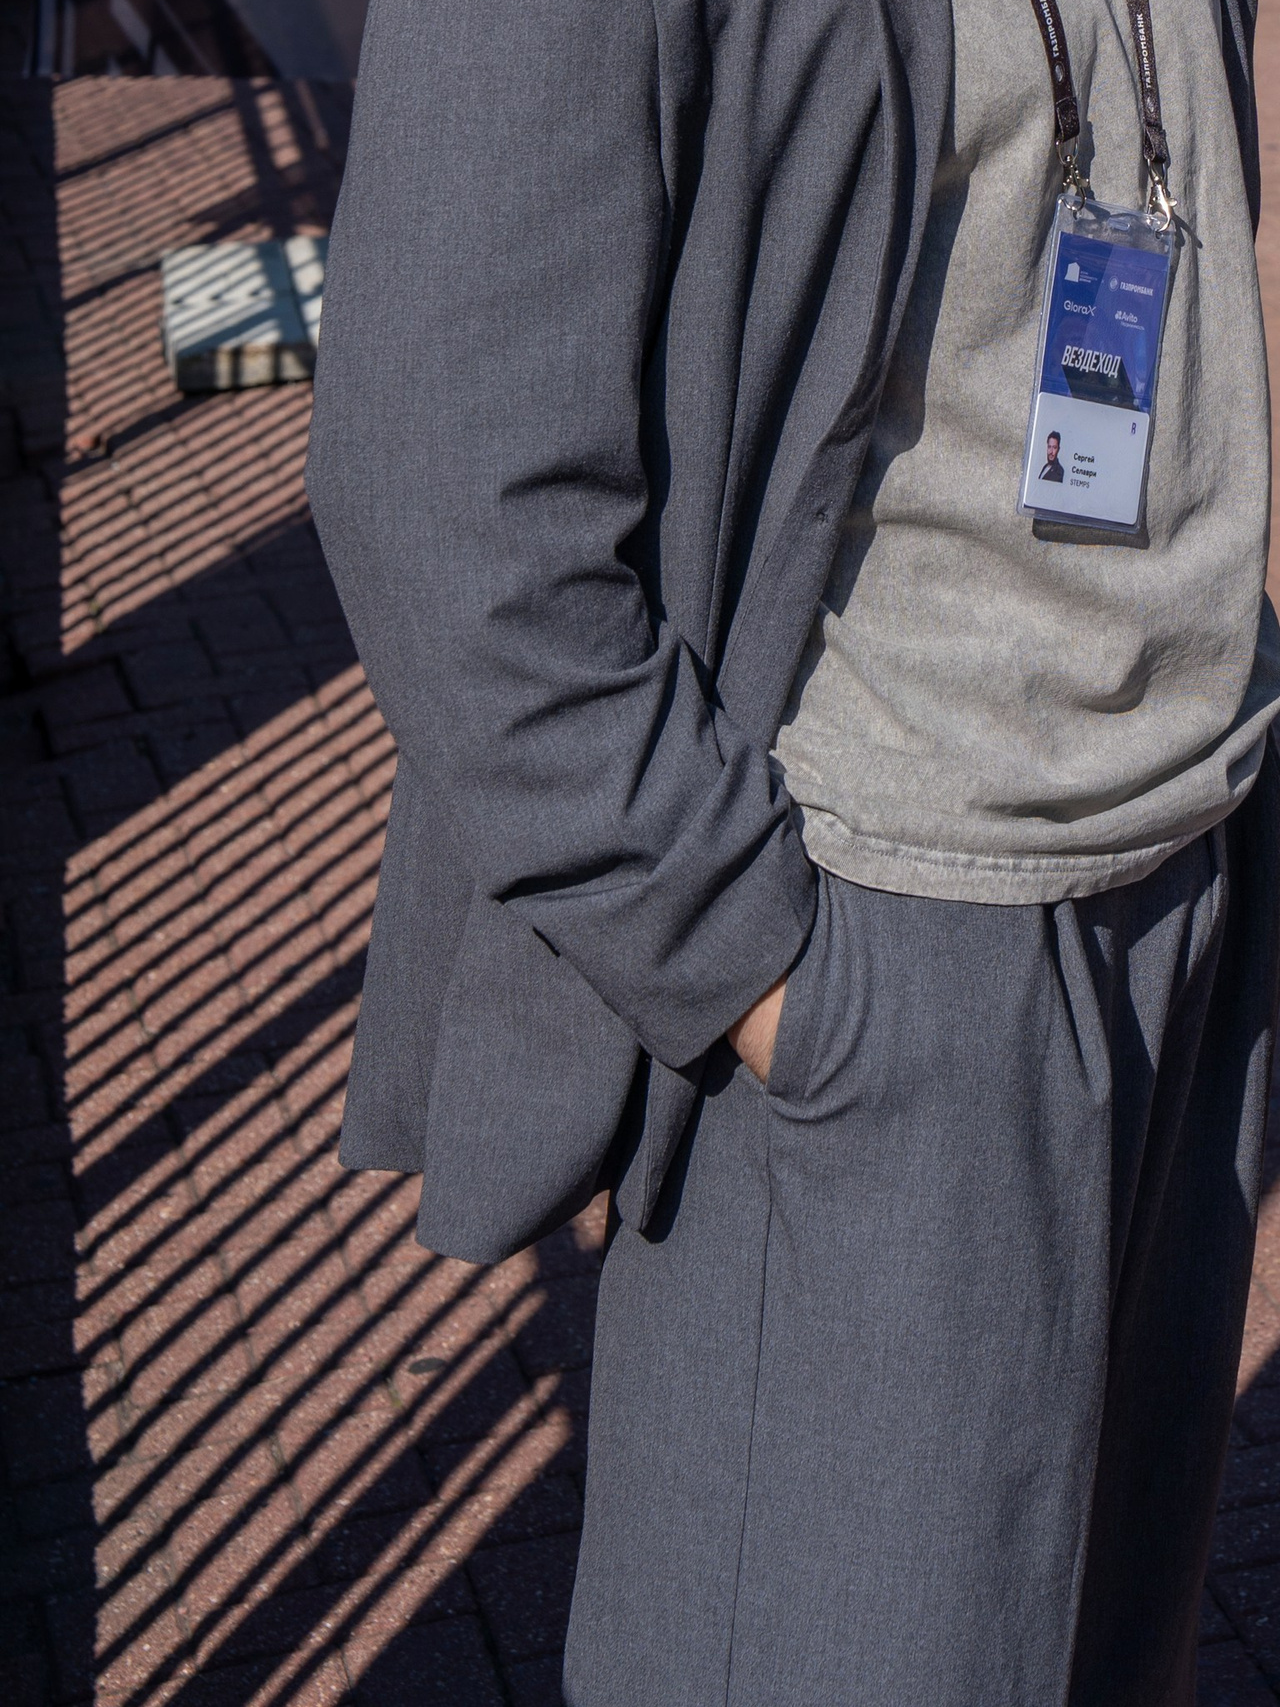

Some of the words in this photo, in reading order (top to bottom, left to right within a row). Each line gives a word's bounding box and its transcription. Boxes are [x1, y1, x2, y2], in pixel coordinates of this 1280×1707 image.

[1136, 13, 1151, 89] ГАЗПРОМБАНК
[1120, 281, 1154, 297] ГАЗПРОМБАНК
[1063, 300, 1097, 316] GloraX
[1061, 345, 1122, 379] ВЕЗДЕХОД
[1073, 452, 1095, 464] Сергей
[1069, 478, 1090, 489] STEMPS
